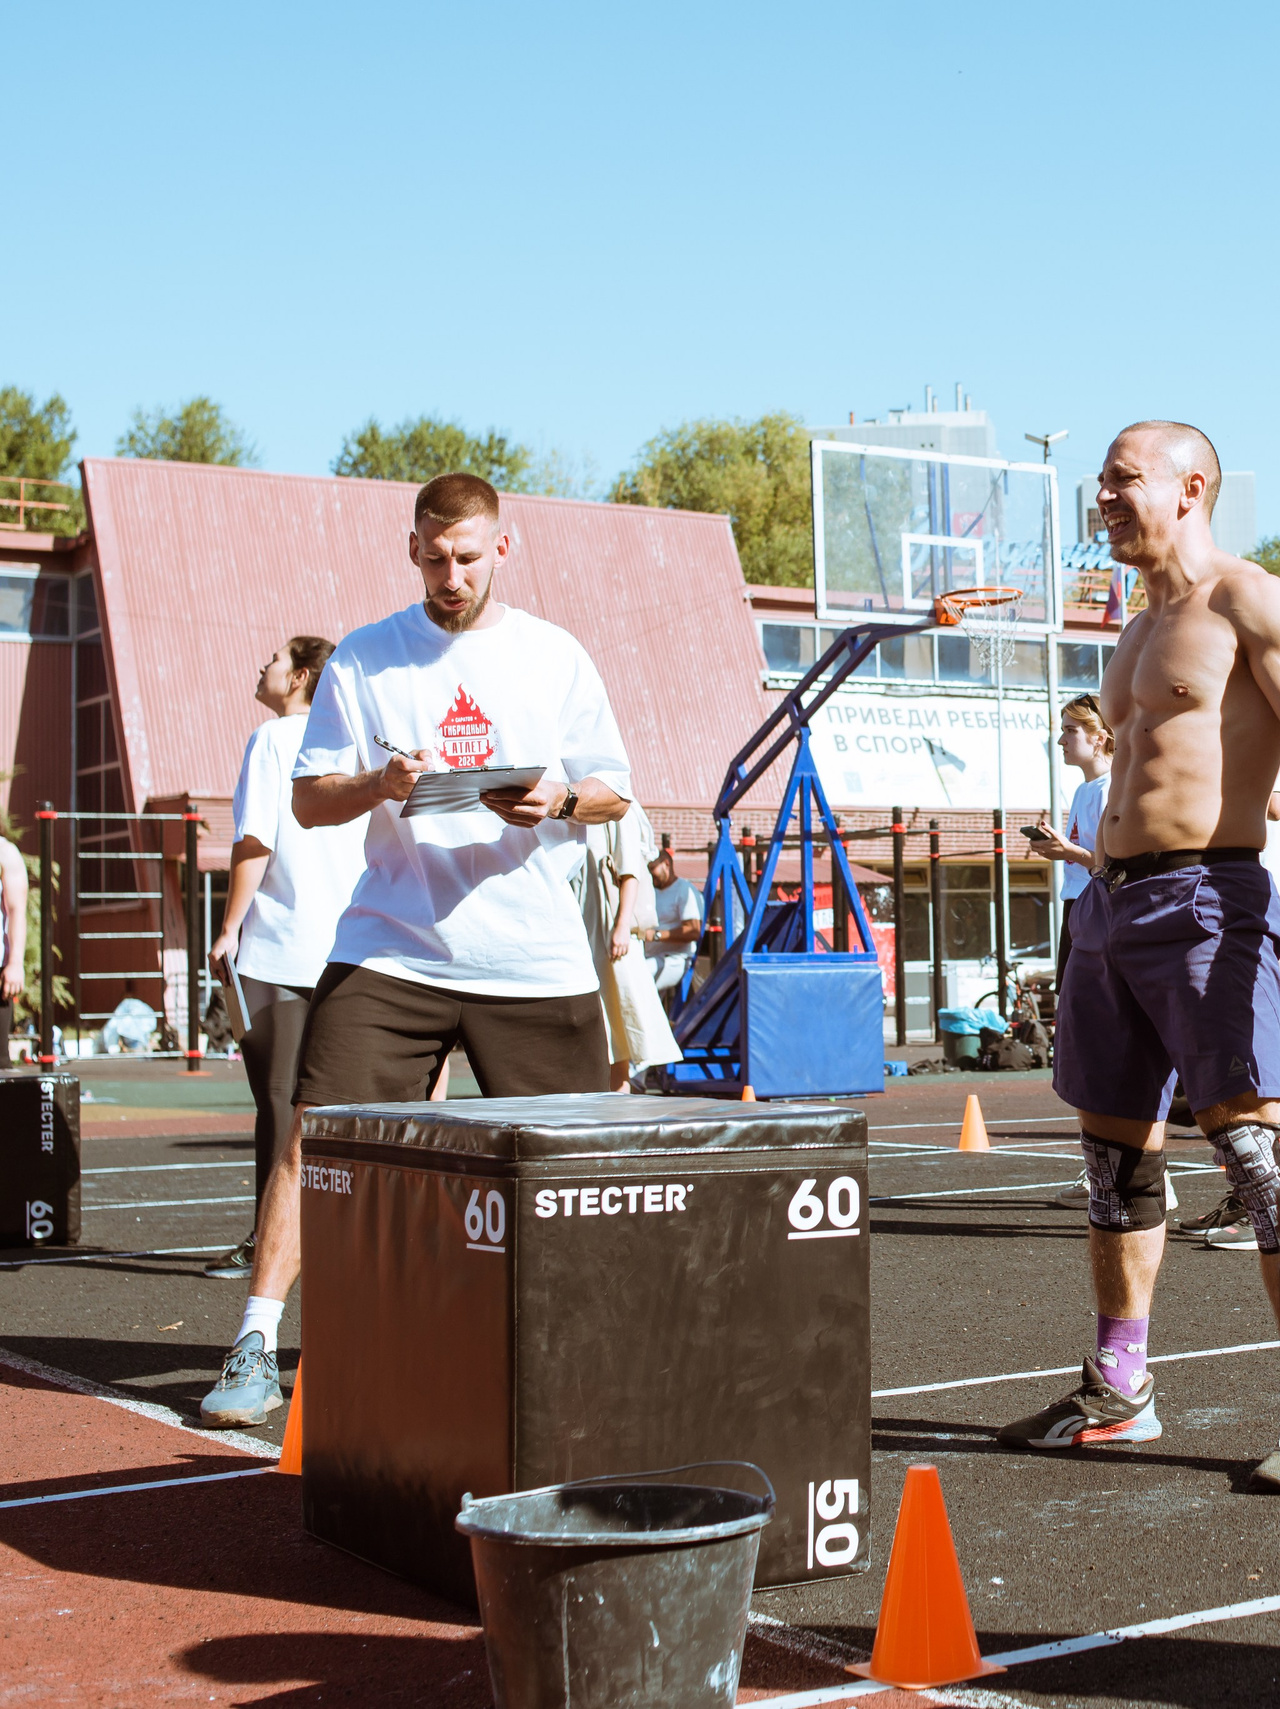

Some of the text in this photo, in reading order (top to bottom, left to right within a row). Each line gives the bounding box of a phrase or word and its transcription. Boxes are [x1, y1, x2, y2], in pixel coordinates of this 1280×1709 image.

[443, 722, 487, 736] ГИБРИДНЫЙ
[826, 705, 941, 729] ПРИВЕДИ
[452, 740, 482, 754] АТЛЕТ
[833, 733, 849, 752] В
[458, 755, 476, 767] 2024
[41, 1081, 54, 1154] STECTER
[301, 1164, 353, 1195] STECTER
[465, 1189, 505, 1245] 60
[535, 1183, 690, 1218] STECTER
[787, 1176, 860, 1232] 60
[30, 1199, 54, 1239] 60
[1258, 1211, 1278, 1249] ROCKTAPE
[817, 1477, 859, 1567] 50
